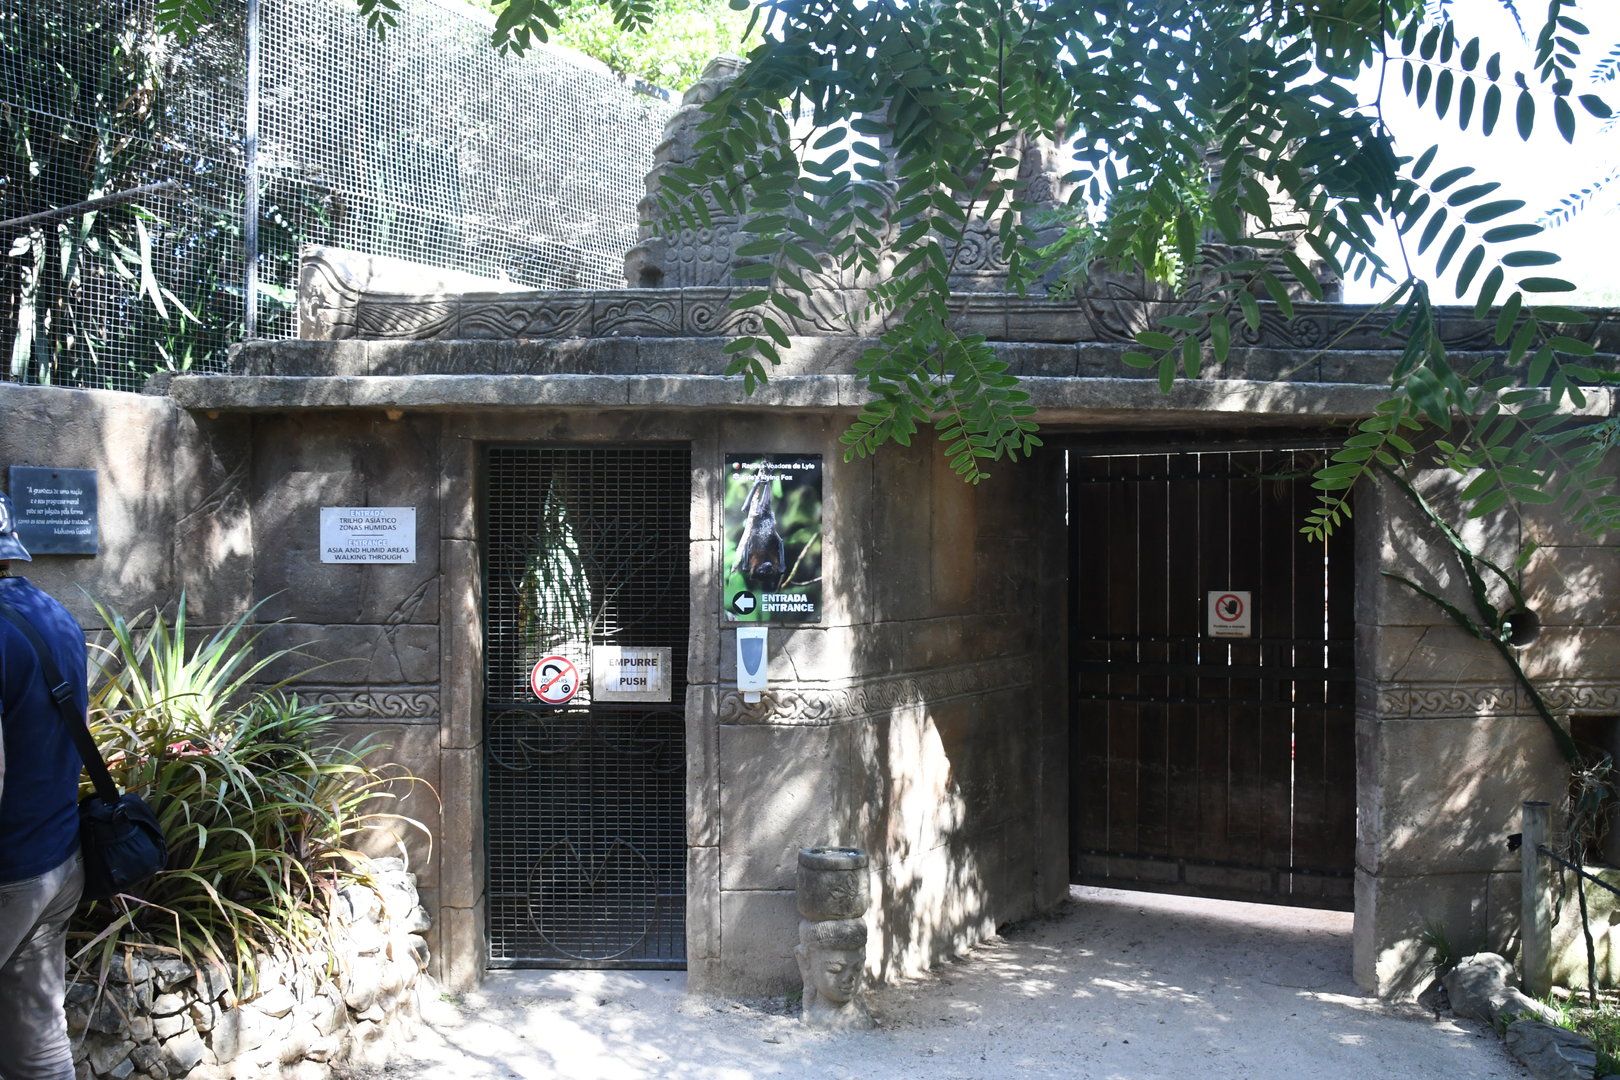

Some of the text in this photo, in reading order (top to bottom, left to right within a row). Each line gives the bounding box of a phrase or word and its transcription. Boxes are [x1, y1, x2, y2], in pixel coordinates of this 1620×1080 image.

[350, 509, 385, 517] ENTRADA
[761, 594, 808, 602] ENTRADA
[761, 603, 814, 612] ENTRANCE
[609, 658, 657, 667] EMPURRE
[620, 677, 647, 686] PUSH
